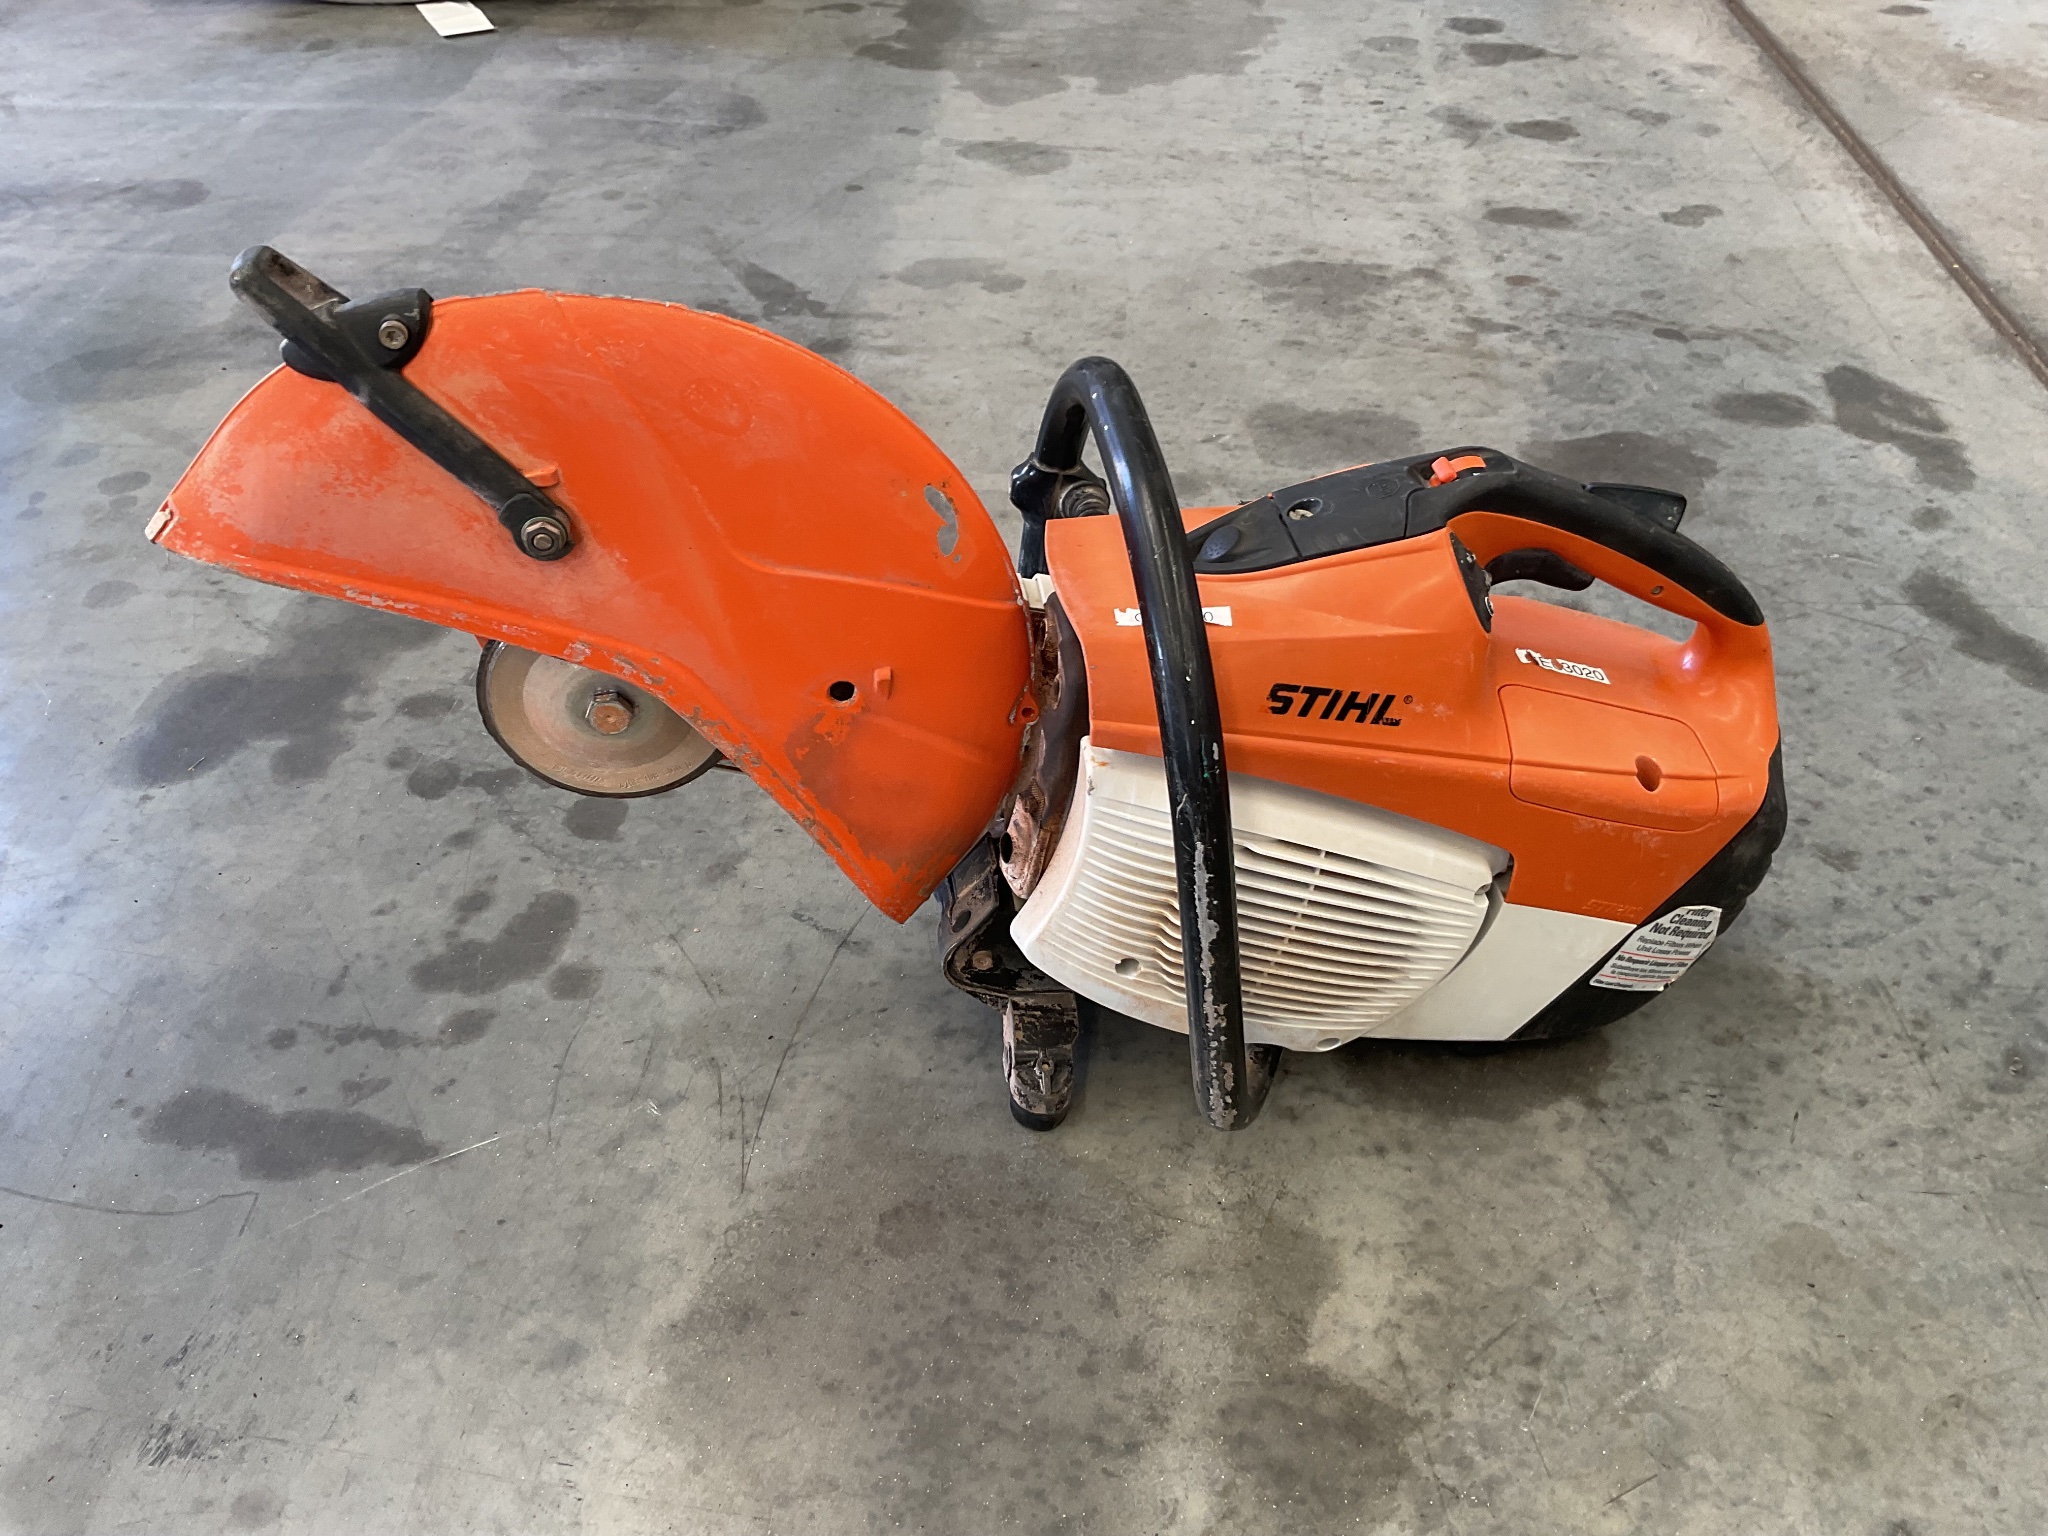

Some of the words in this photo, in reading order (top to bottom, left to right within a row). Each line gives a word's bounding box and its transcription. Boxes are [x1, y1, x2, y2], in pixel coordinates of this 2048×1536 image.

[1561, 662, 1605, 681] 3020
[1267, 683, 1402, 727] STIHL
[1669, 913, 1713, 930] Cleaning
[1649, 922, 1671, 935] Not
[1669, 925, 1714, 940] Required
